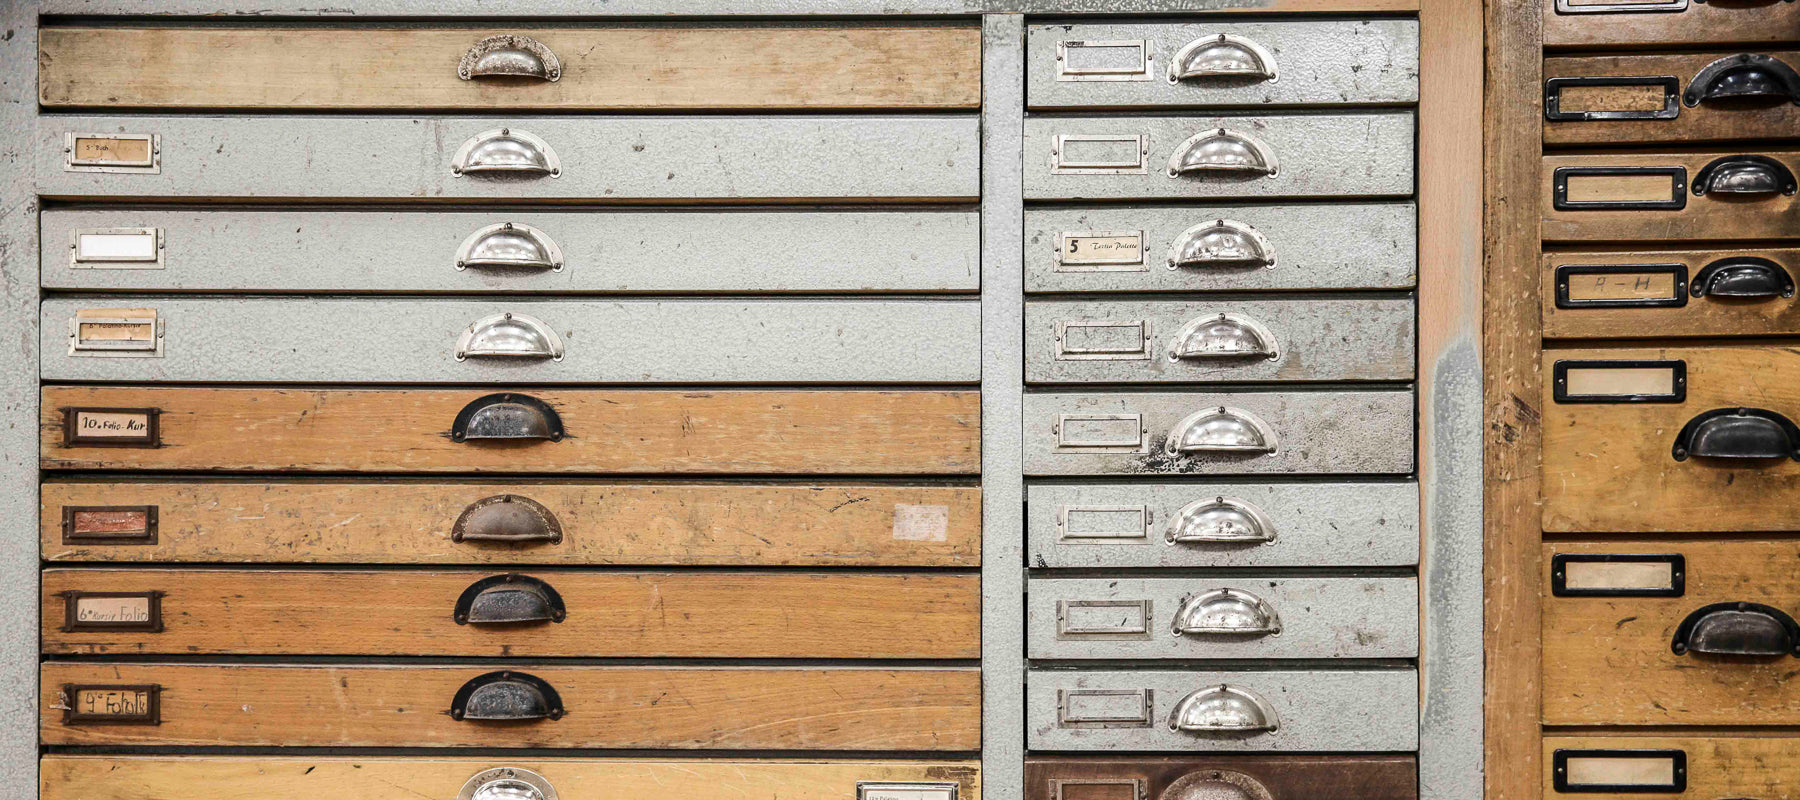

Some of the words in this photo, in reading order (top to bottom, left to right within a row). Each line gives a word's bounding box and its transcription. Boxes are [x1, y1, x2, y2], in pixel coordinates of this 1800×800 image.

[1069, 239, 1079, 253] 5
[1634, 276, 1650, 290] H
[120, 605, 148, 621] Folio
